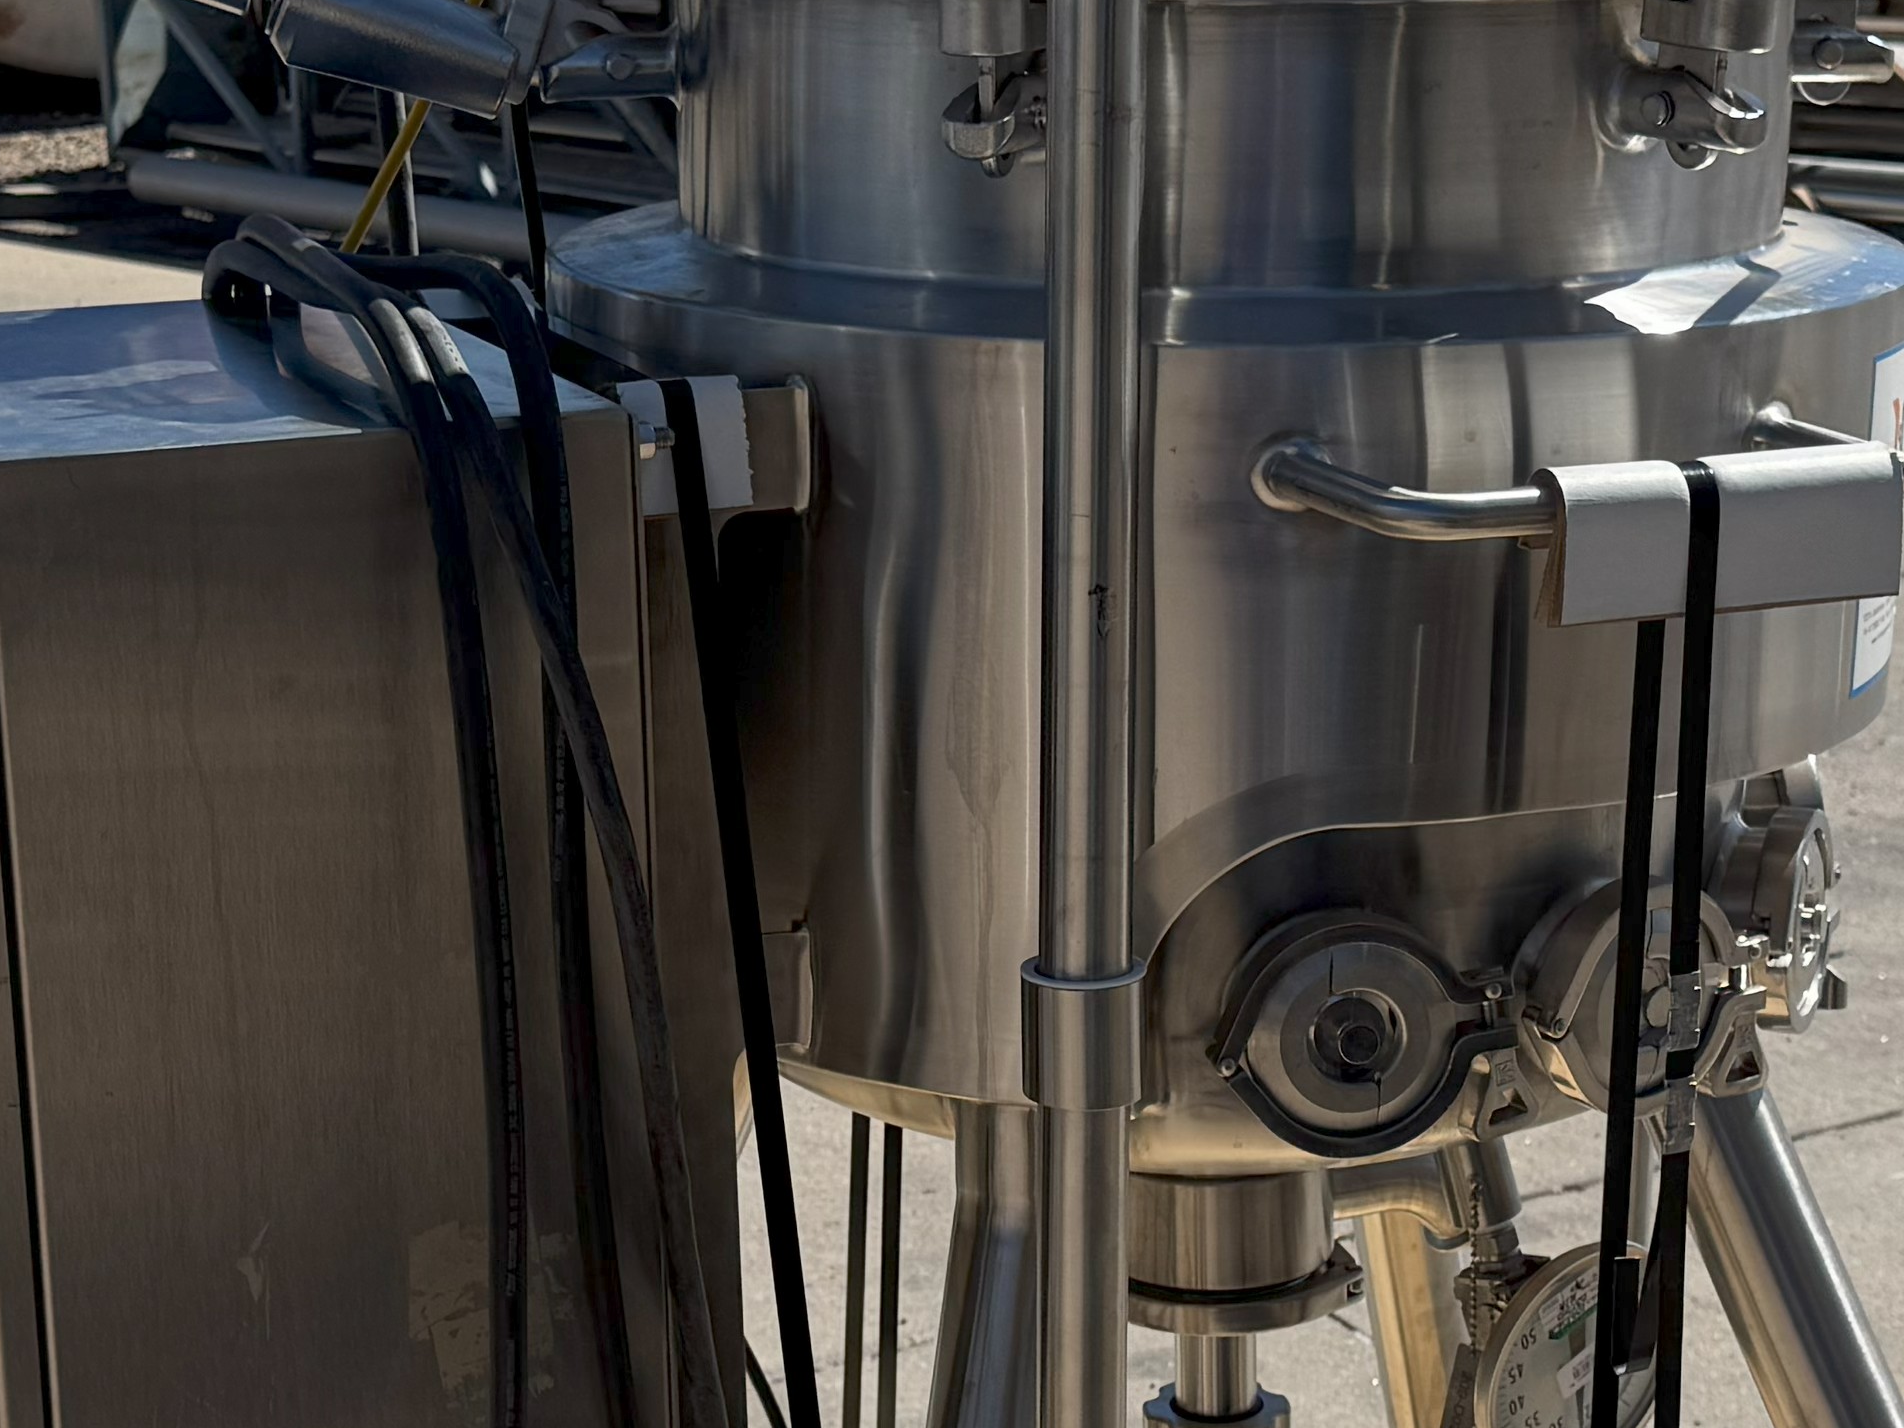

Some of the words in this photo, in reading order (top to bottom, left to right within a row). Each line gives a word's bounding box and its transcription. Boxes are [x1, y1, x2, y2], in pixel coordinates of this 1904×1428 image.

[1520, 1327, 1538, 1351] 50
[1507, 1363, 1524, 1385] 45
[1509, 1395, 1526, 1416] 40
